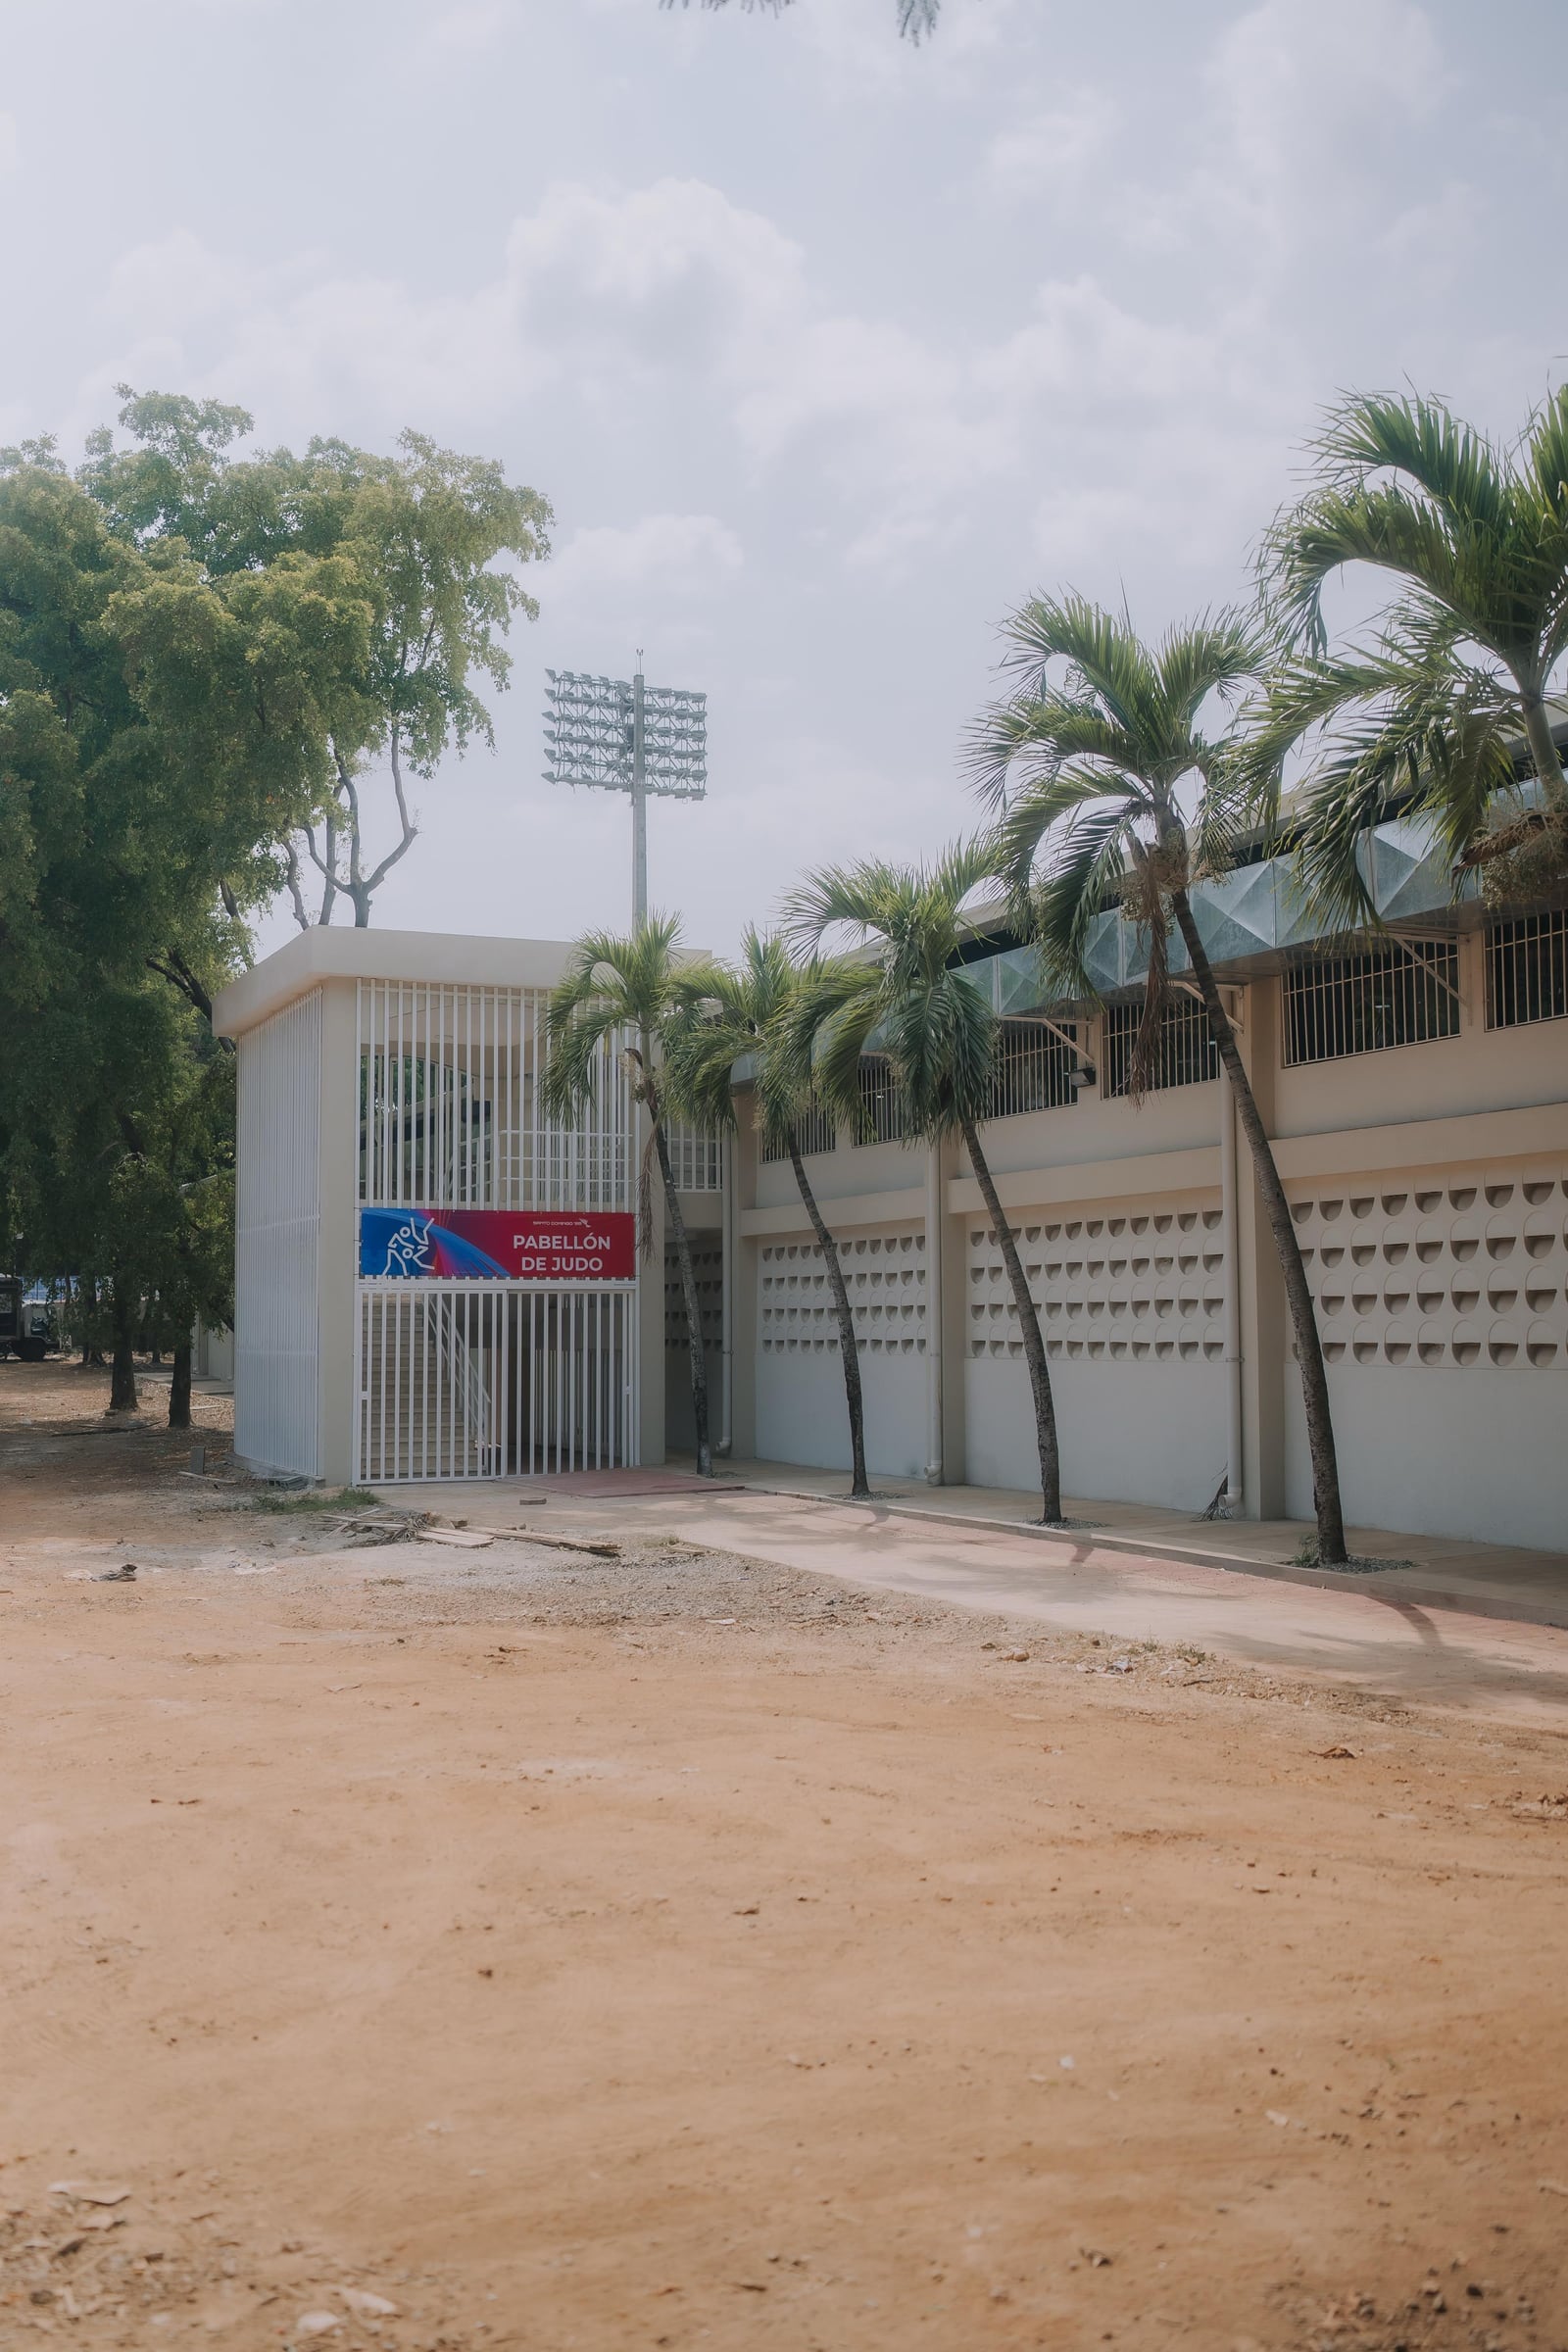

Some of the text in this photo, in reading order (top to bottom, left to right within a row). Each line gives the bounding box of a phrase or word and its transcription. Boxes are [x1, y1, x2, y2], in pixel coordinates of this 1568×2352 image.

[513, 1232, 611, 1250] PABELLÓN
[521, 1256, 603, 1272] DE JUDO
